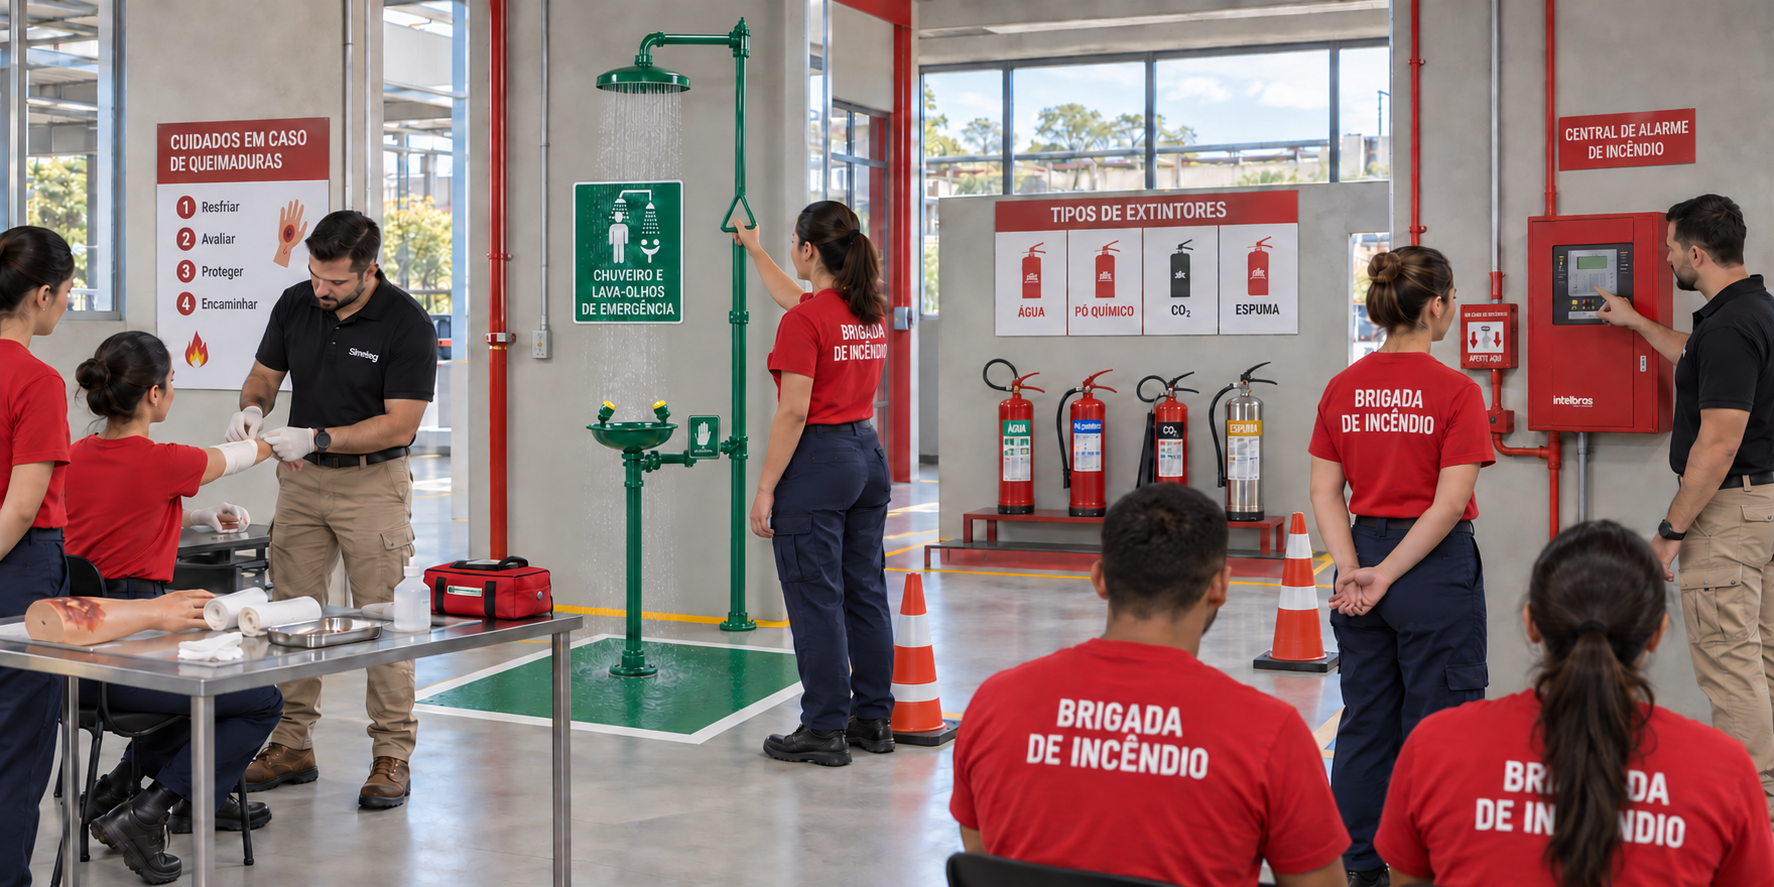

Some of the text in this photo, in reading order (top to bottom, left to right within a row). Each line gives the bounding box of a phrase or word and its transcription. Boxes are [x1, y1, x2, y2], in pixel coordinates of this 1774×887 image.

[1565, 120, 1689, 141] CENTRAL DE ALARME
[170, 129, 307, 150] CUIDADOS EM CASO
[1588, 140, 1664, 159] DE INCÊNDIO
[170, 153, 282, 173] DE QUEIMADURAS
[182, 200, 240, 214] 1 Resfriar
[1050, 201, 1227, 223] TIPOS DE EXTINTORES
[182, 232, 236, 246] 2 Avaliar
[182, 264, 244, 280] 3 Proteger
[593, 269, 664, 281] CHUVEIRO E
[592, 285, 665, 298] LAVA-OLHOS
[181, 296, 258, 311] 4 Encaminhar
[581, 303, 596, 315] DE
[1017, 304, 1045, 318] ÁGUA
[1075, 303, 1135, 319] PÓ QUÍMICO
[1235, 303, 1280, 315] ESPUMA
[840, 323, 886, 340] BRIGADA
[834, 345, 848, 361] DE
[1355, 389, 1423, 408] BRIGADA
[1553, 395, 1593, 405] intelbras
[1341, 407, 1434, 435] DE INCÊNDIO
[1056, 698, 1183, 738] BRIGADA
[1026, 733, 1209, 780] DE INCÊNDIO
[1503, 760, 1670, 806] BRIDA
[1475, 798, 1686, 848] DE INNDIO
